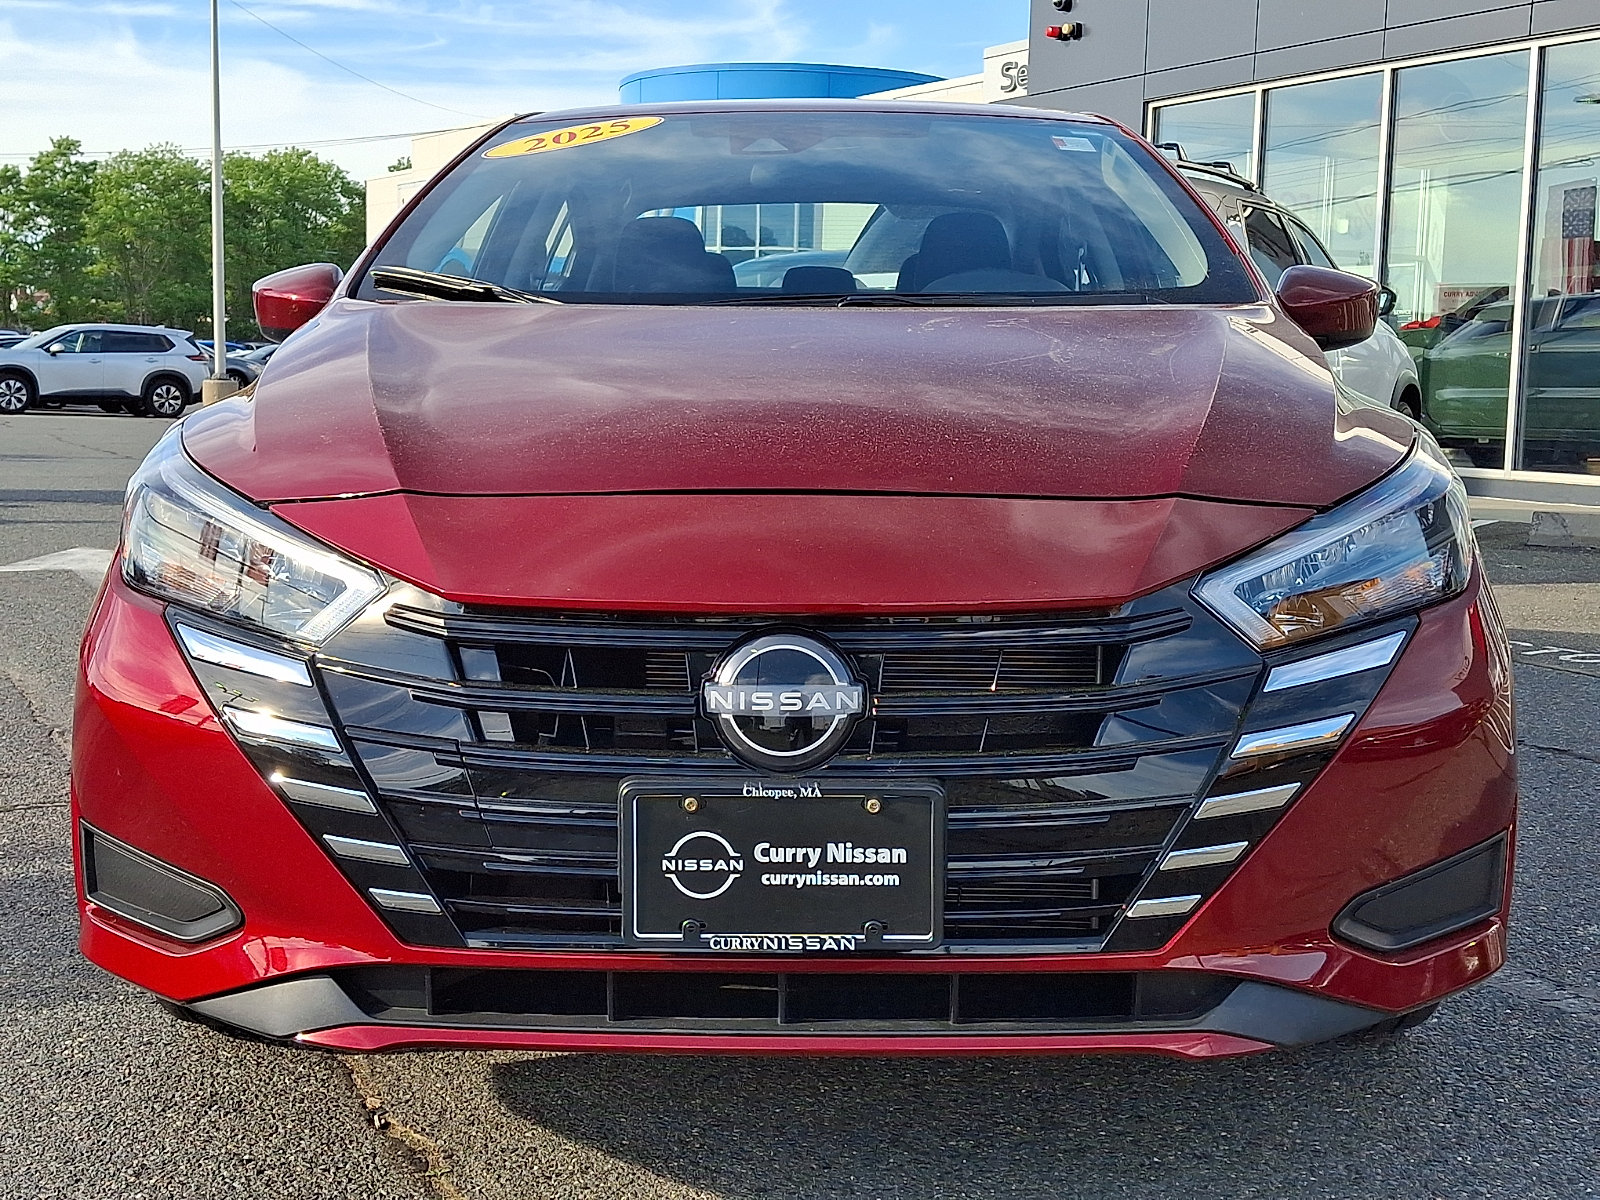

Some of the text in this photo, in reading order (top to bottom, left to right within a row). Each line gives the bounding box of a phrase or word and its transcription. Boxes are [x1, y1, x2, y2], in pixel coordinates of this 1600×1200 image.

[523, 119, 631, 152] 2025
[709, 690, 859, 711] NISSAN
[799, 785, 822, 798] MA
[753, 841, 907, 868] Curry Nissan
[661, 858, 744, 872] NISSAN
[761, 869, 900, 889] currynissan.com
